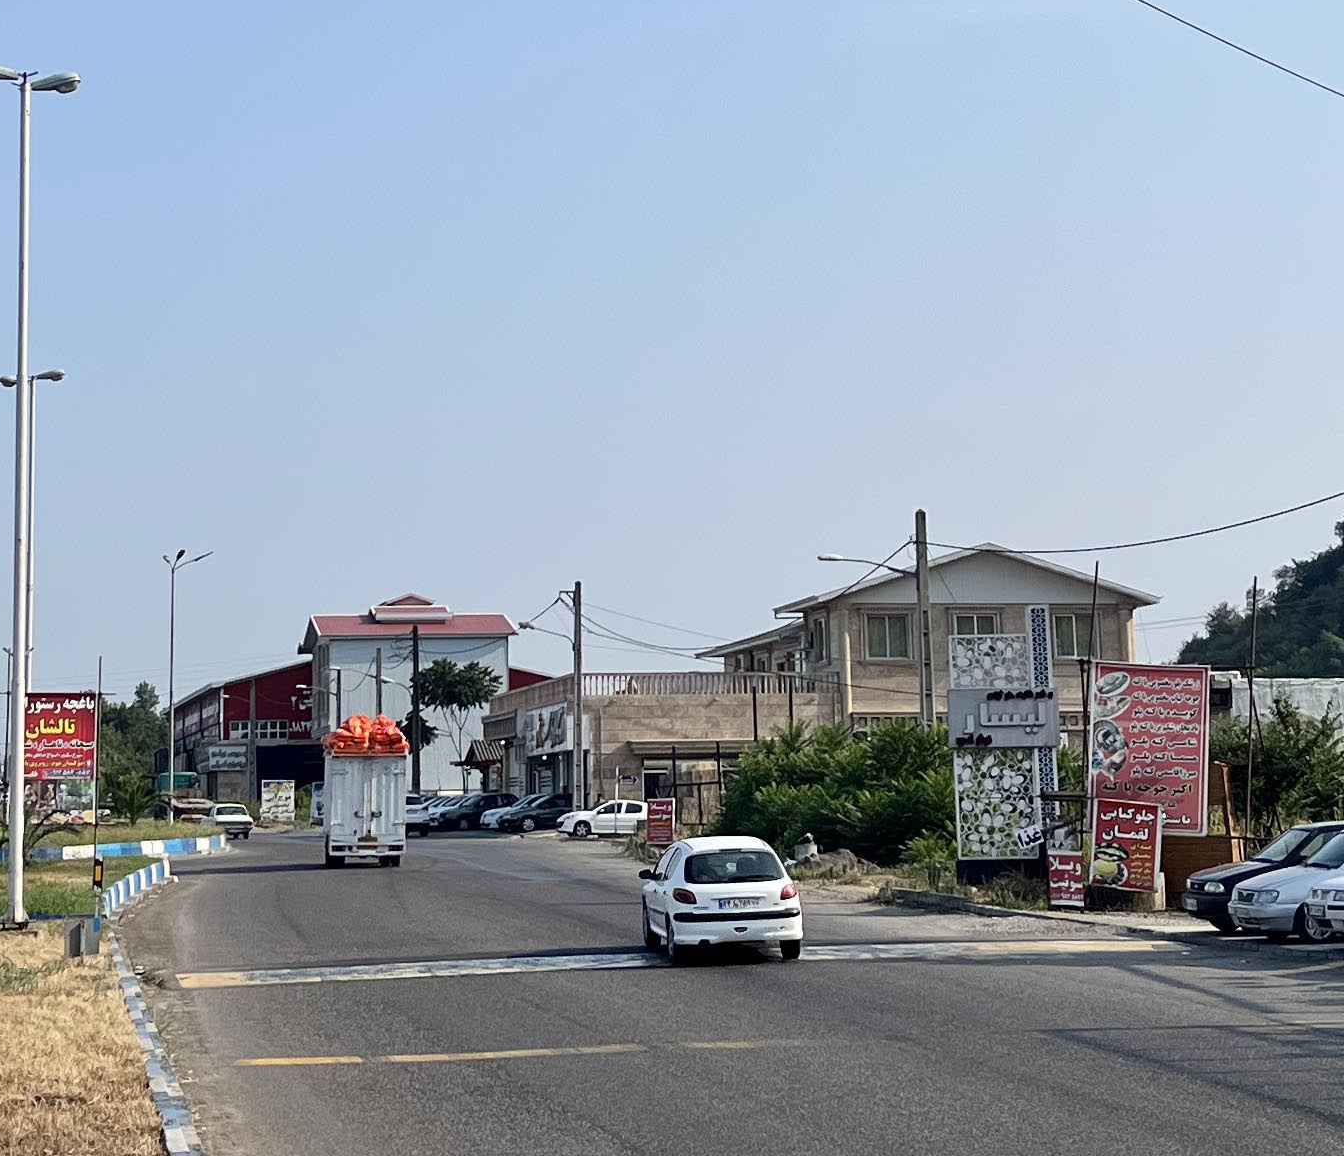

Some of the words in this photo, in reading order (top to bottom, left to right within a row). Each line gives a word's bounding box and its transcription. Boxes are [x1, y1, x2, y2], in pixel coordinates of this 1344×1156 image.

[24, 696, 61, 714] رستورا
[62, 696, 95, 714] باغچه
[25, 717, 76, 739] تالشان
[1151, 737, 1166, 747] کته
[1153, 751, 1168, 761] کته
[1102, 781, 1120, 792] کته
[1123, 781, 1132, 794] با
[1135, 784, 1168, 797] جوجه
[1171, 784, 1193, 797] اکبر
[1017, 827, 1042, 848] غذا
[1102, 824, 1149, 841] لقمان
[1049, 856, 1082, 876] ویلا
